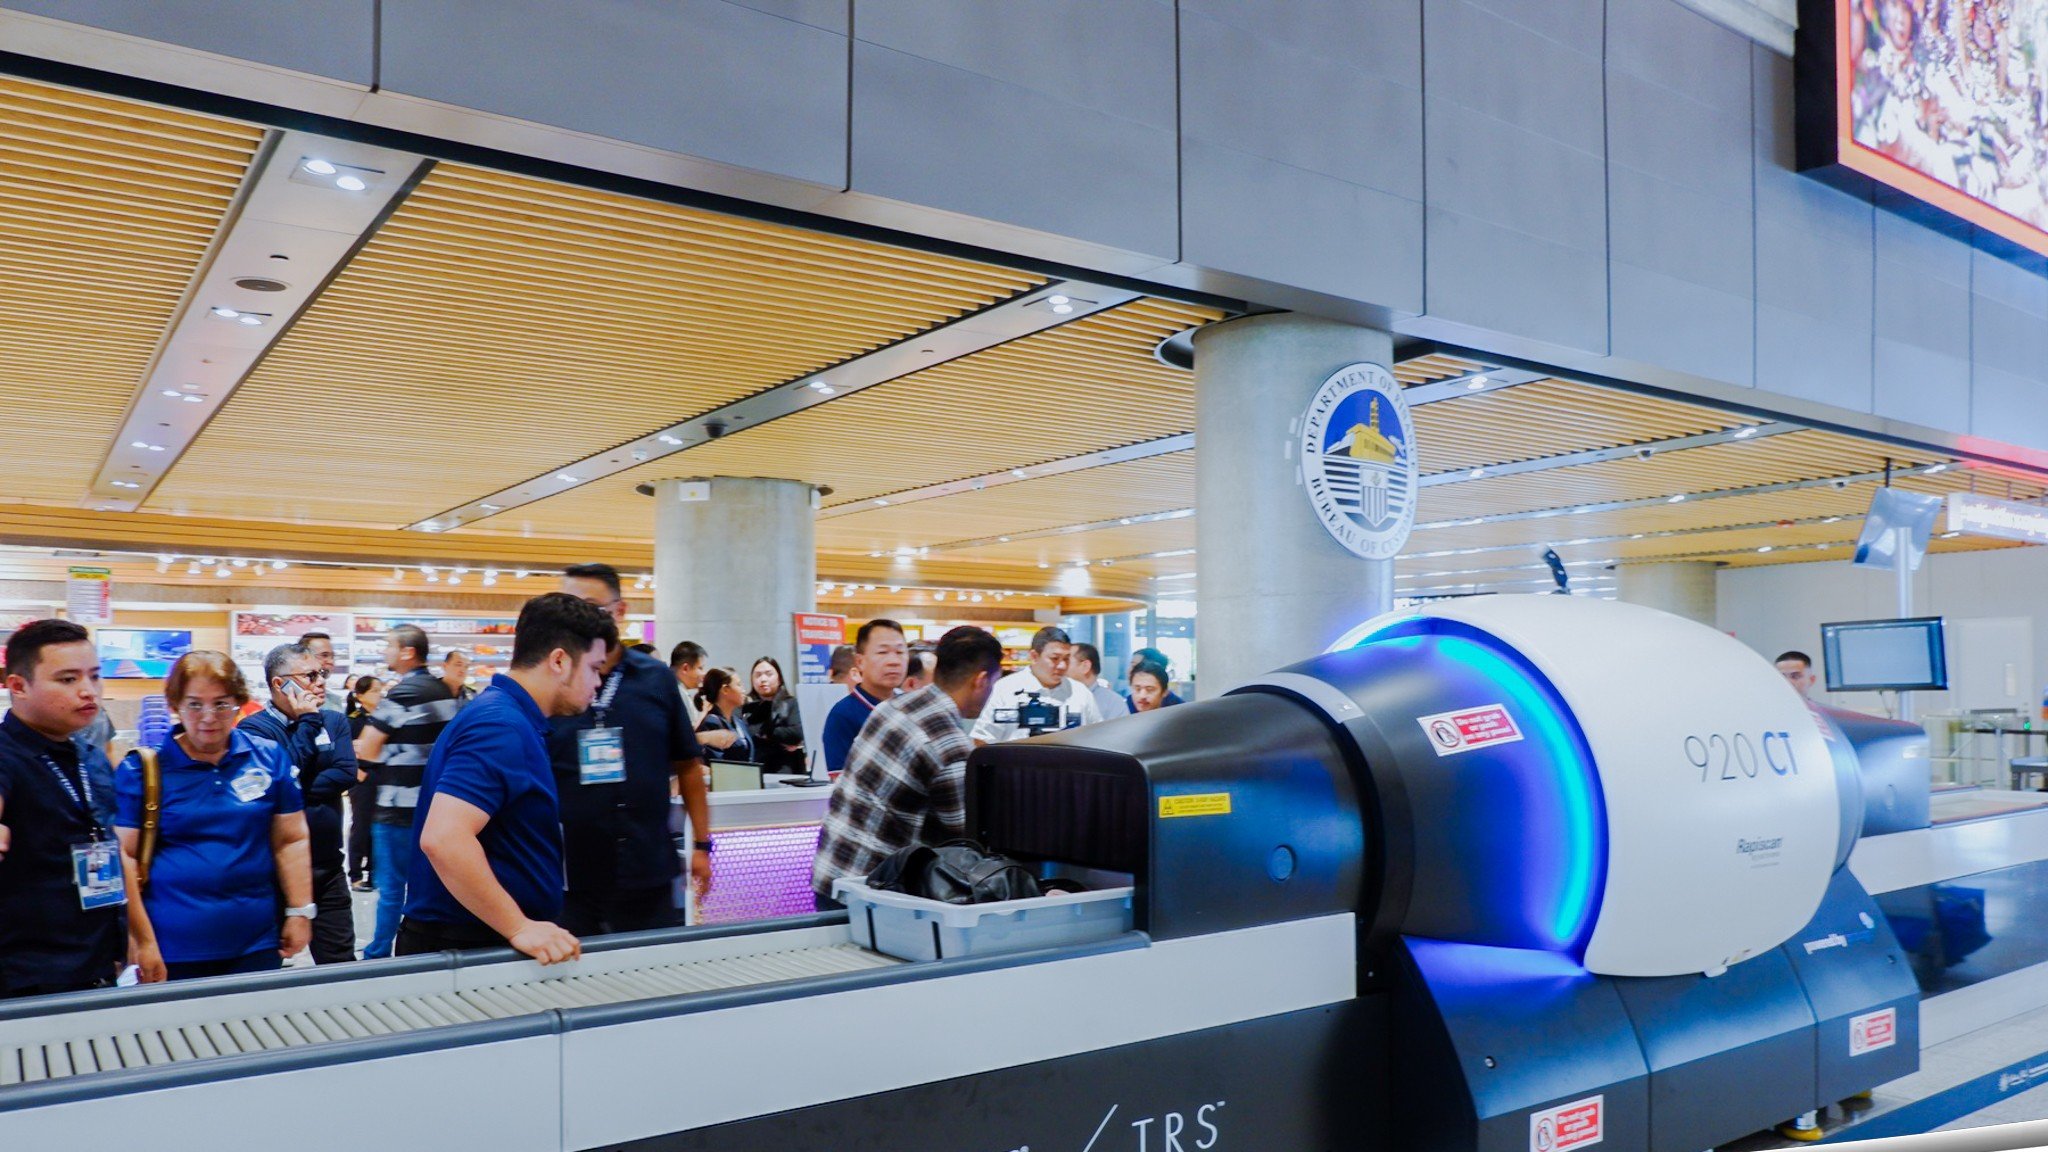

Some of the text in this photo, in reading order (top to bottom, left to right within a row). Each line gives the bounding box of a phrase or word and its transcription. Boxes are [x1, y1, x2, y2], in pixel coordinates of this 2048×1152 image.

[1305, 370, 1375, 454] DEPARTMENT
[1379, 375, 1393, 393] OF
[1311, 477, 1357, 546] BUREAU
[1360, 538, 1378, 555] OF
[1684, 731, 1799, 783] 920 CT
